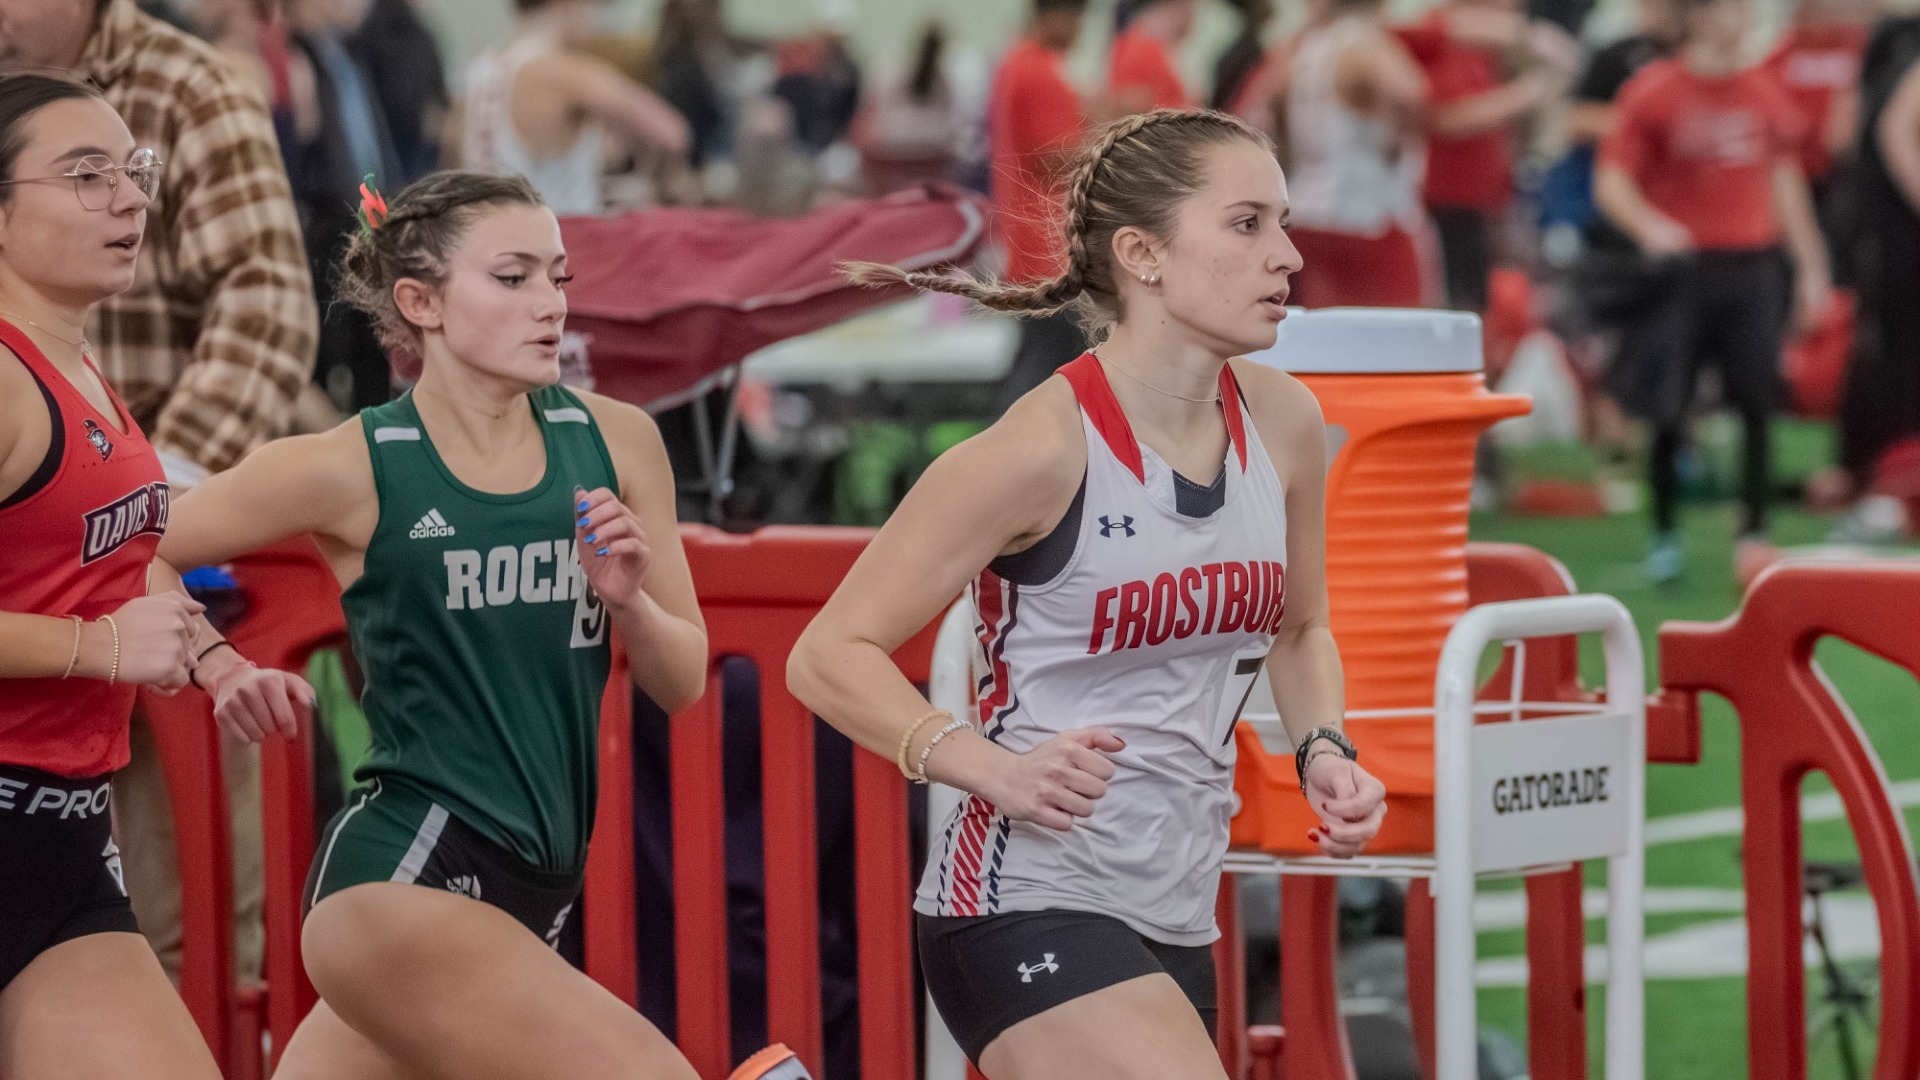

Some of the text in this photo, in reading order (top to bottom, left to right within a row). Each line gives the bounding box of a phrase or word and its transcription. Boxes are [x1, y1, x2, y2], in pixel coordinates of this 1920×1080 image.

[89, 492, 149, 555] DAVIS
[409, 525, 456, 540] adidas
[1222, 656, 1267, 747] 7
[25, 782, 110, 820] PRO
[1493, 766, 1609, 814] GATORADE
